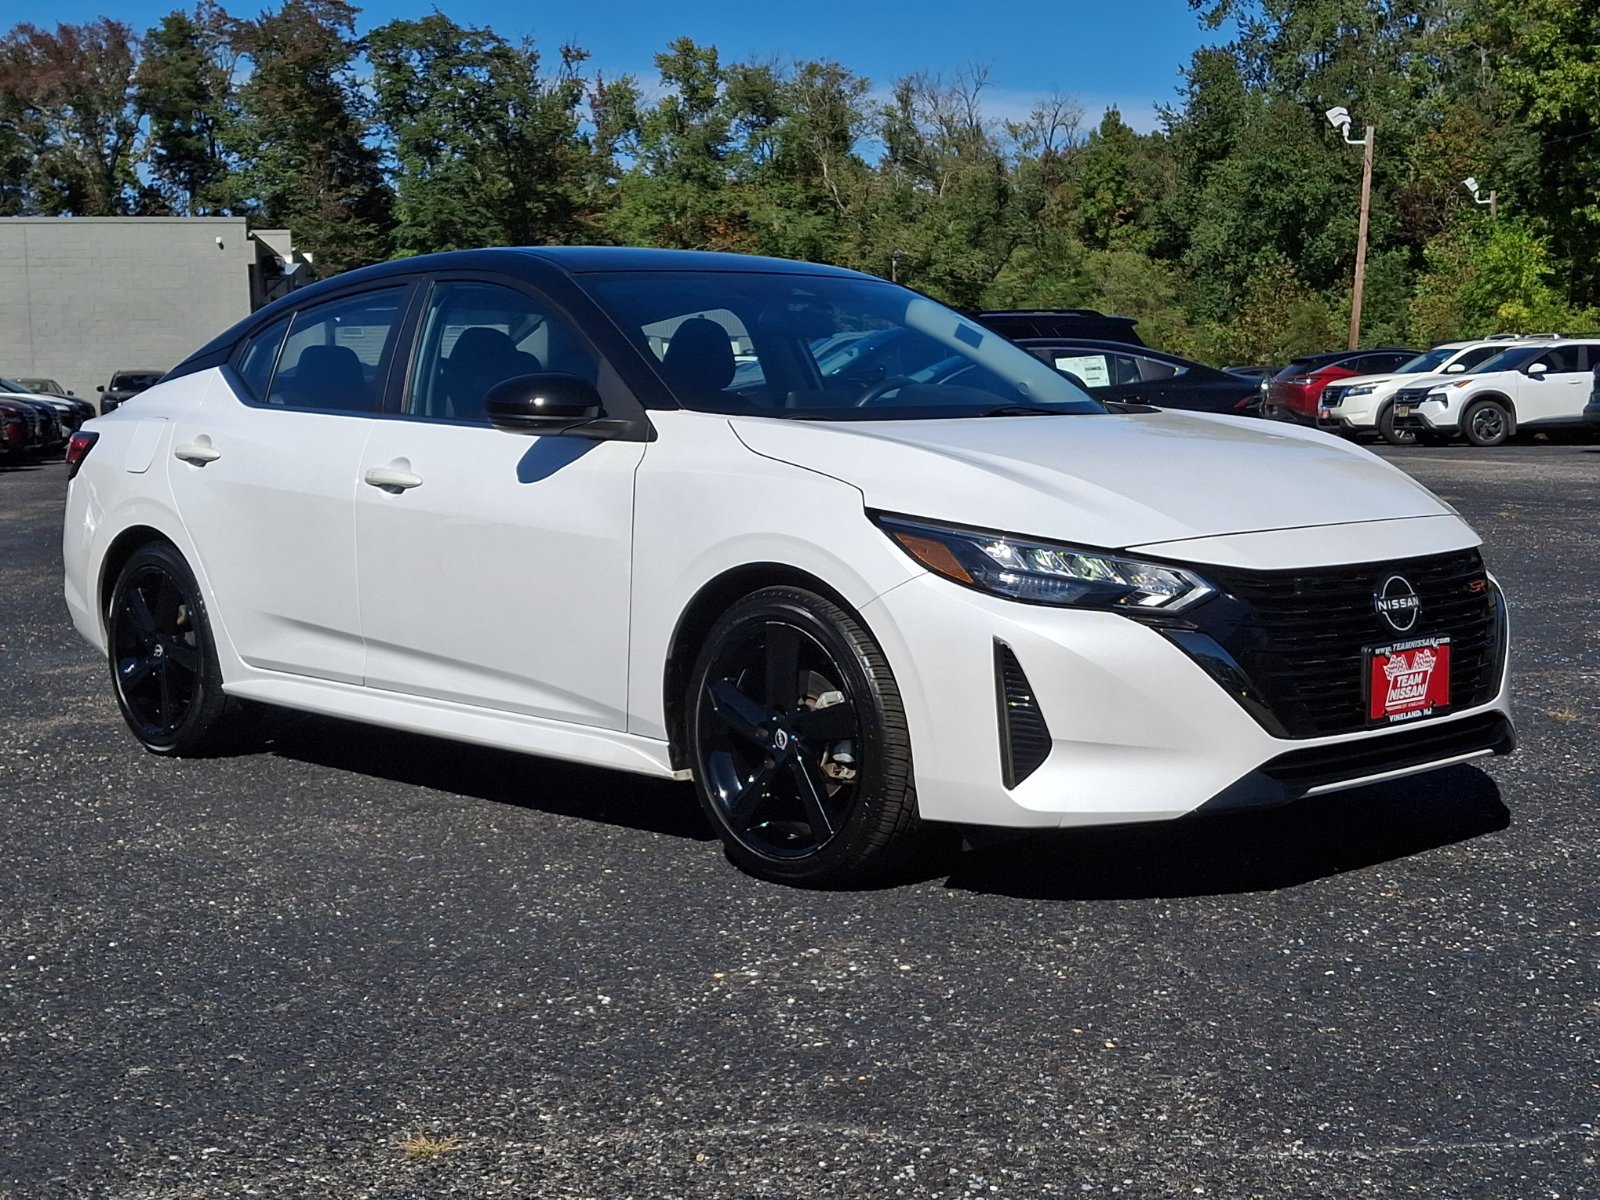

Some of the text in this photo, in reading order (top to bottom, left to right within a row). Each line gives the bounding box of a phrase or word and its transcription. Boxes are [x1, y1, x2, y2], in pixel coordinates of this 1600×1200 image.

[1378, 597, 1419, 610] NISSAN
[1397, 673, 1423, 687] TEAM
[1389, 684, 1425, 701] NISSAN
[1423, 707, 1432, 715] NJ
